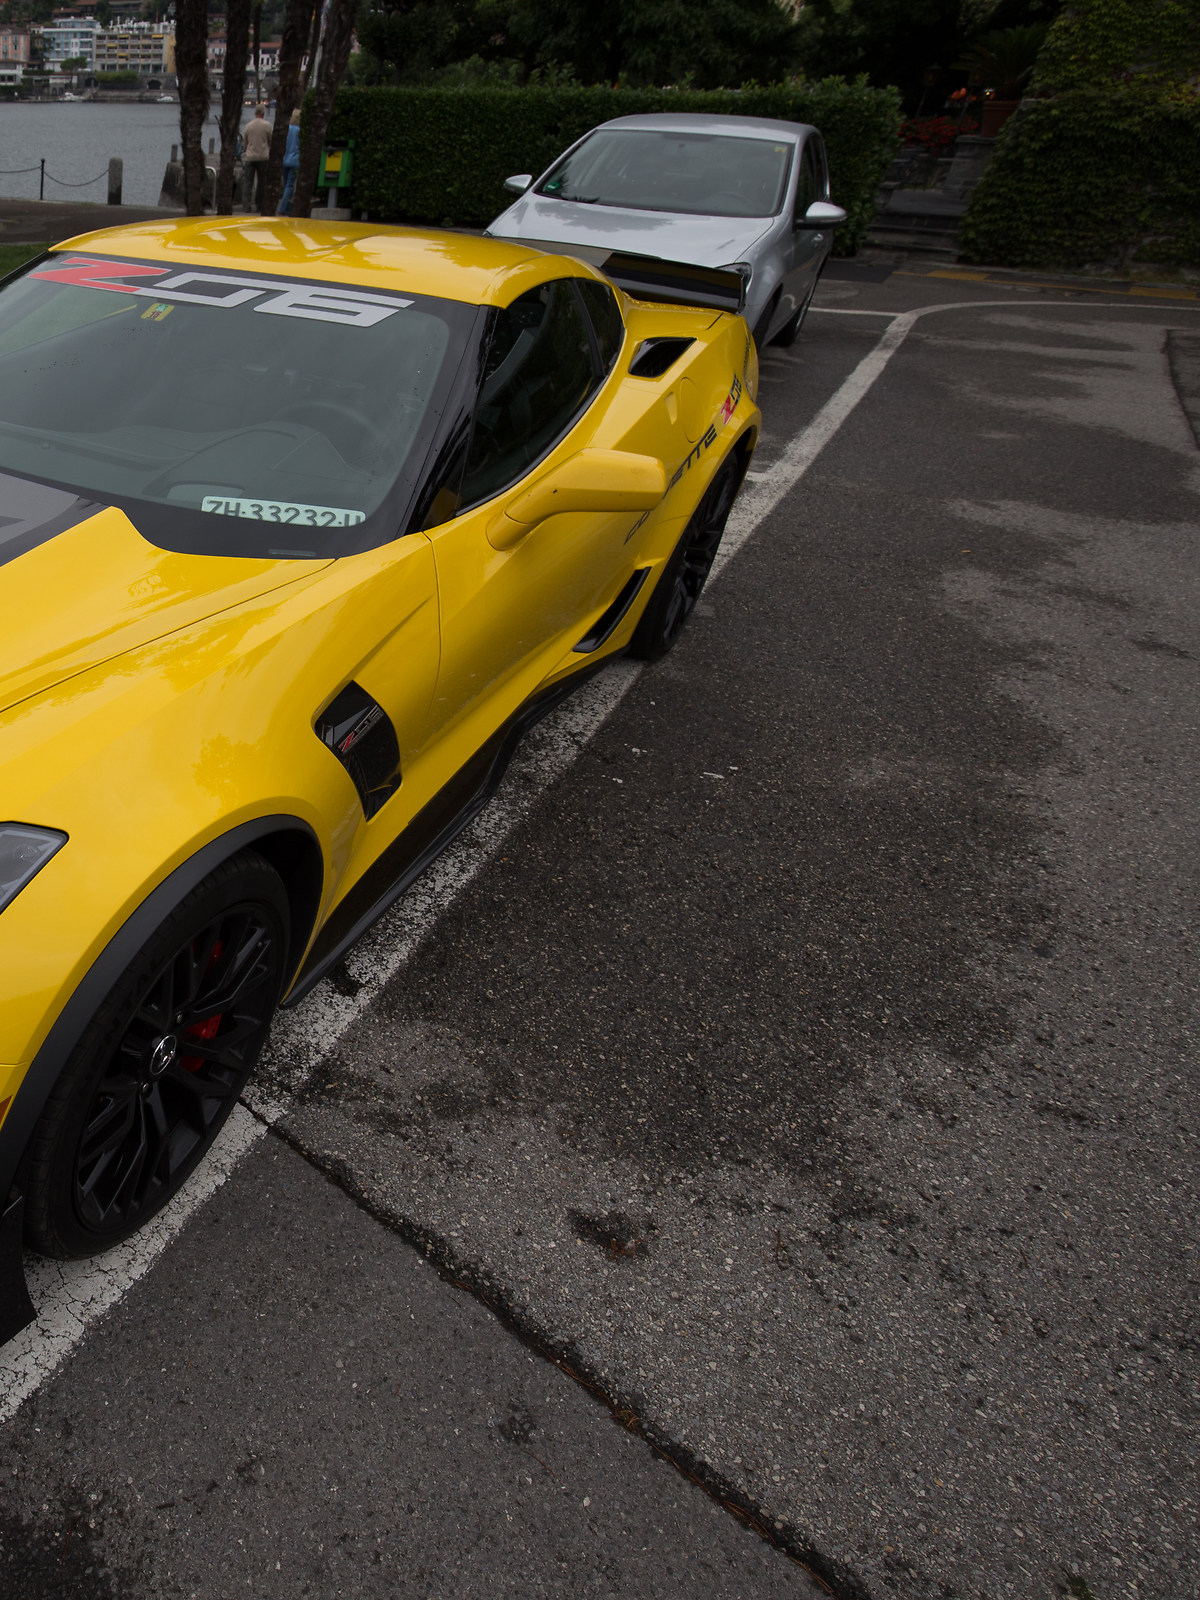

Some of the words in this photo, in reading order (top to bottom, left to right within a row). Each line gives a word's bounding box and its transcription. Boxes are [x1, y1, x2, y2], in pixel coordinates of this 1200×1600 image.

[28, 257, 415, 327] Z06
[623, 423, 717, 546] COETTE
[720, 373, 742, 425] Z06
[338, 704, 383, 753] Z06
